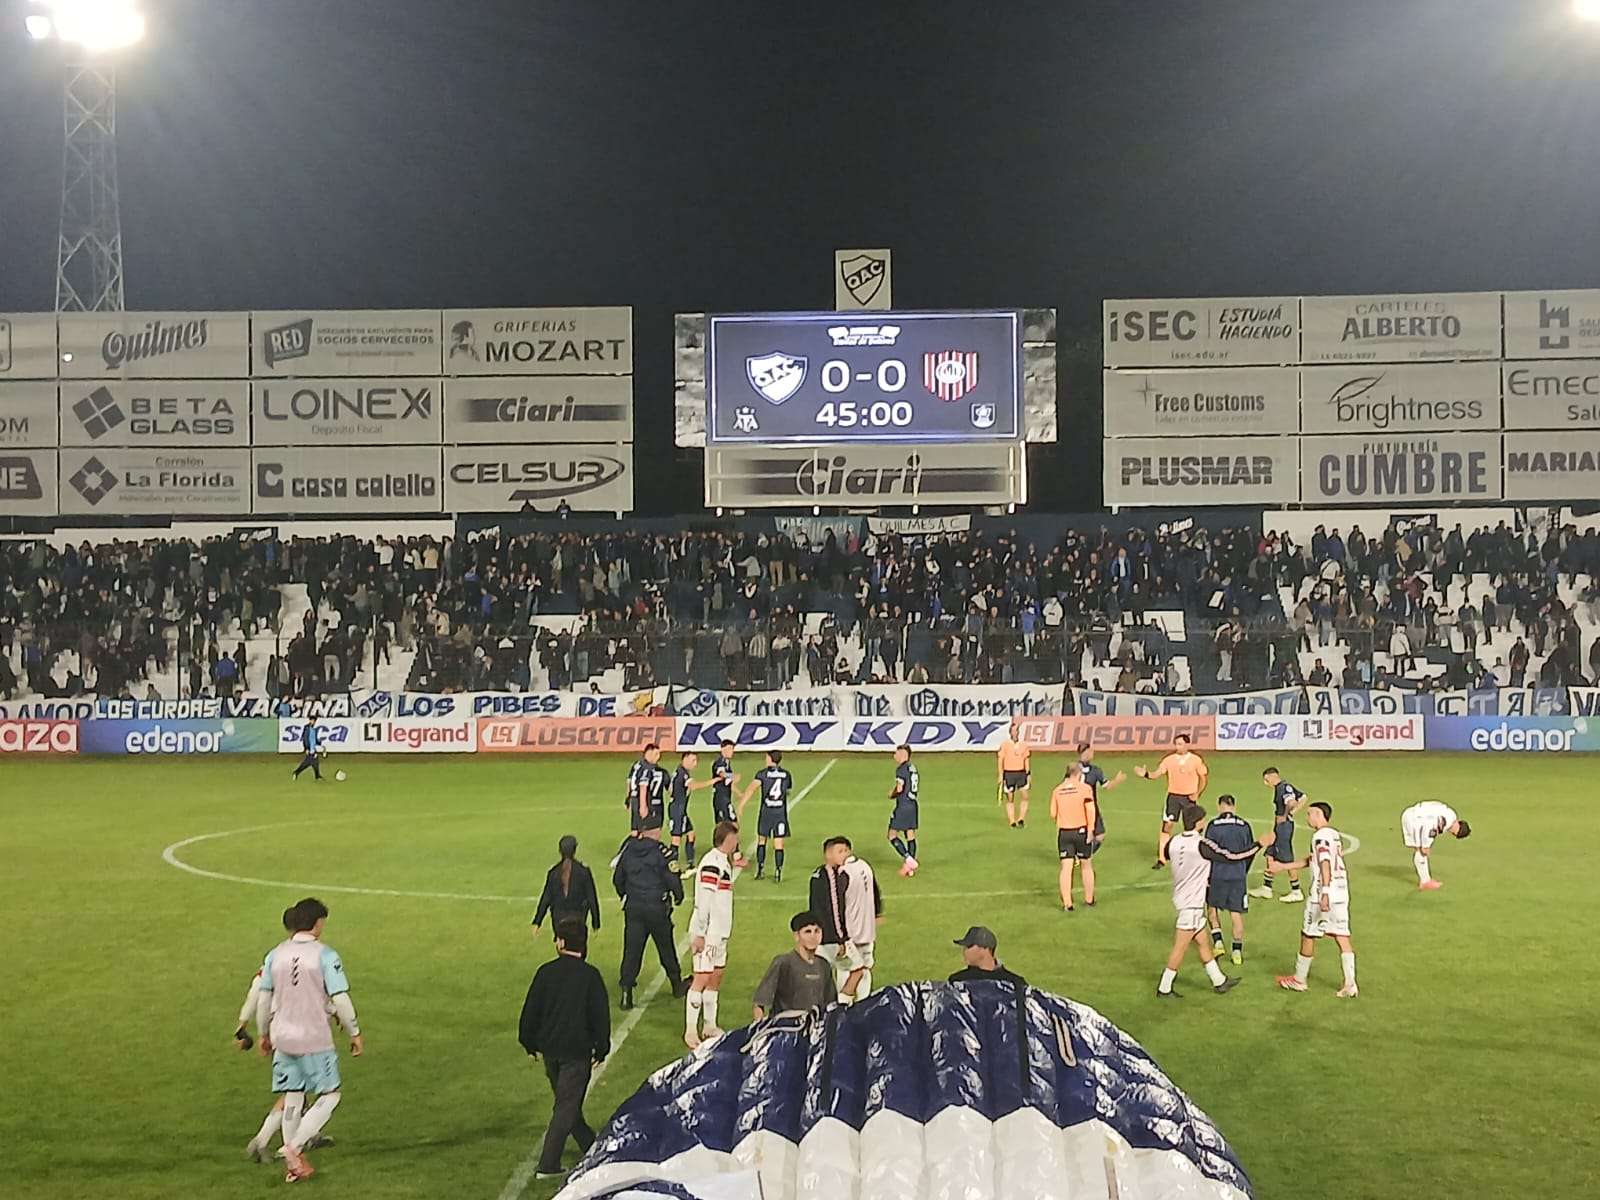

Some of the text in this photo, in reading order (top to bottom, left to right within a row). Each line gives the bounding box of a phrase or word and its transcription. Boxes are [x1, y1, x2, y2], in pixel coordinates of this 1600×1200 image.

[847, 261, 883, 288] QAC
[494, 320, 577, 333] GRIFERIAS
[1220, 325, 1292, 340] HACIENDO
[1341, 315, 1461, 344] ALBERTO
[102, 319, 208, 370] Quilmes
[271, 329, 304, 352] RED
[486, 340, 625, 362] MOZART
[131, 398, 234, 415] BETA
[263, 388, 431, 420] LOINEX
[498, 396, 575, 422] Ciari
[816, 402, 912, 426] 45:00
[1155, 394, 1265, 412] Free Customs
[1337, 395, 1482, 428] brightness
[1568, 404, 1600, 421] Sal
[131, 419, 234, 434] GLASS
[450, 461, 605, 483] CELSUR
[1121, 456, 1273, 486] PLUSMAR
[1508, 451, 1600, 472] MARIA
[125, 472, 234, 487] La Florida
[292, 474, 435, 497] casa calello
[797, 456, 922, 496] Ciari
[1319, 452, 1487, 496] CUMBRE
[95, 700, 214, 719] LOS CURDAS
[398, 694, 617, 717] LOS PIBES DE
[126, 725, 223, 753] edenor
[282, 725, 349, 743] sca
[388, 722, 469, 748] legrand
[678, 722, 838, 746] KDY
[847, 721, 1009, 745] KDY
[1329, 720, 1414, 746] legrand
[1471, 722, 1576, 751] edenor
[770, 778, 782, 800] 4
